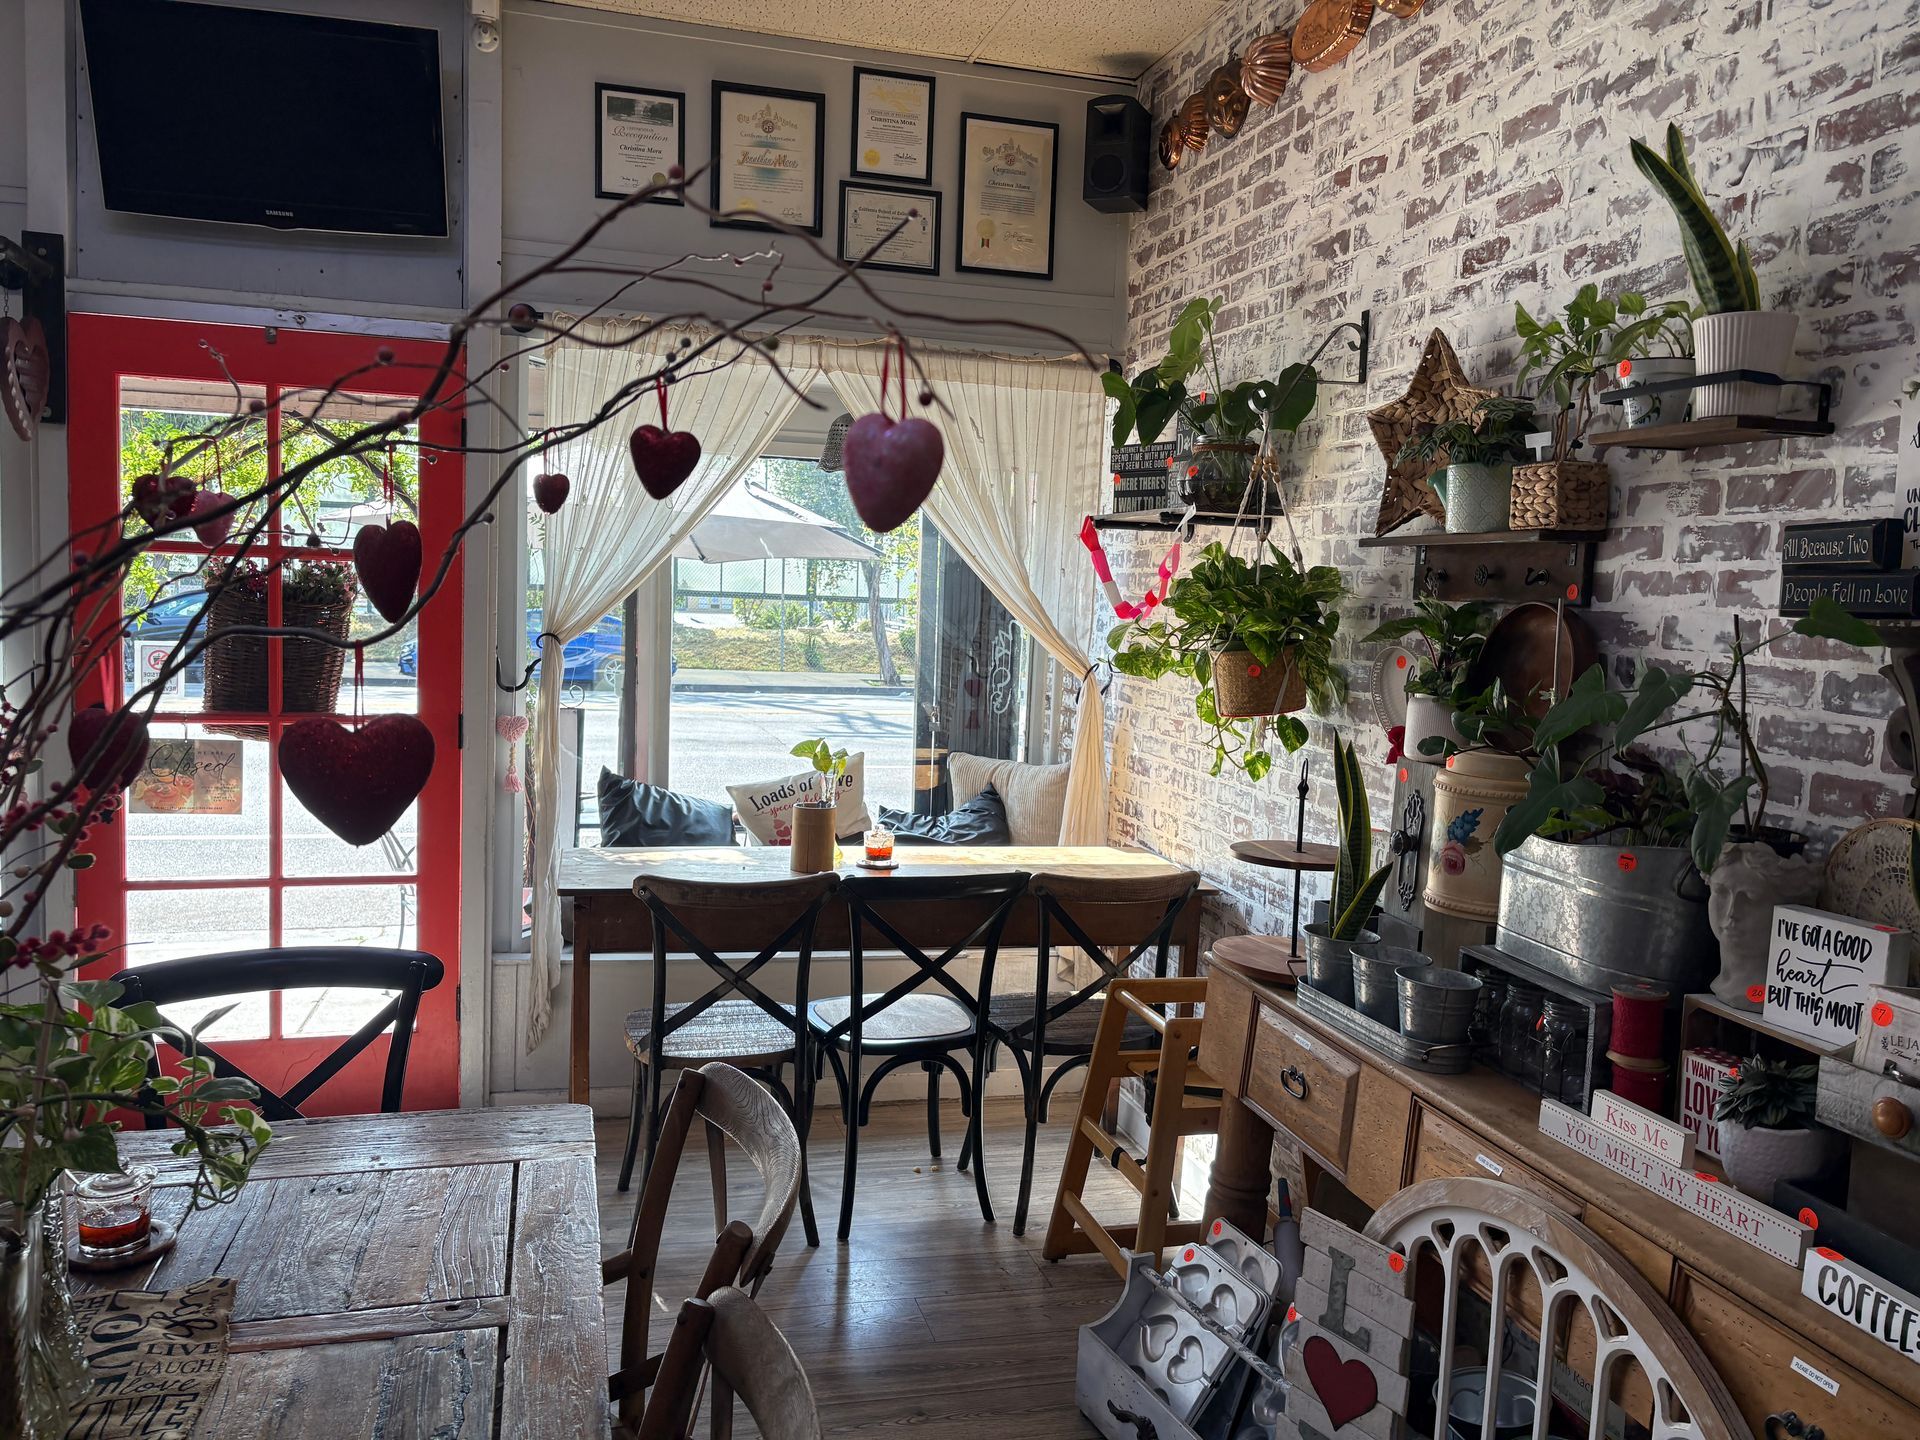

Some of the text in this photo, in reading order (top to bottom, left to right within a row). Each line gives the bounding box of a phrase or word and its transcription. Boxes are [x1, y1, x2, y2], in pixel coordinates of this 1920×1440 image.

[870, 115, 900, 125] CHRISTINA
[619, 143, 646, 153] Christina
[265, 209, 294, 217] SAMSUNG
[1111, 453, 1129, 463] SPEND
[1130, 452, 1143, 462] TIME
[1144, 451, 1158, 461] WITH
[1125, 461, 1140, 470] SEEM
[1140, 460, 1153, 469] LIKE
[1139, 475, 1166, 491] THERE'S
[1118, 496, 1142, 513] WANT
[1143, 495, 1154, 511] TO
[1783, 532, 1870, 561] All Because Two
[1832, 582, 1856, 603] Fell
[1858, 588, 1872, 604] in
[1874, 583, 1909, 605] Love
[148, 743, 236, 787] Closed
[748, 782, 796, 812] Loads
[799, 776, 814, 793] of
[1777, 918, 1873, 964] I'VE GOT A GOOD
[1776, 948, 1864, 995] heart
[1767, 984, 1865, 1036] BUT THIS MOUT
[1890, 1035, 1904, 1047] LE
[1691, 1059, 1716, 1084] WANT
[1684, 1077, 1724, 1121] LOV
[1604, 1104, 1670, 1152] Kiss Me
[1564, 1122, 1765, 1238] YOU MELT MY HEART
[145, 1342, 221, 1356] LIVE
[134, 1359, 217, 1377] LAUGH
[1794, 1361, 1810, 1375] PLEASE
[1814, 1374, 1824, 1384] NOT
[1822, 1379, 1834, 1391] OPEN
[118, 1377, 201, 1397] love
